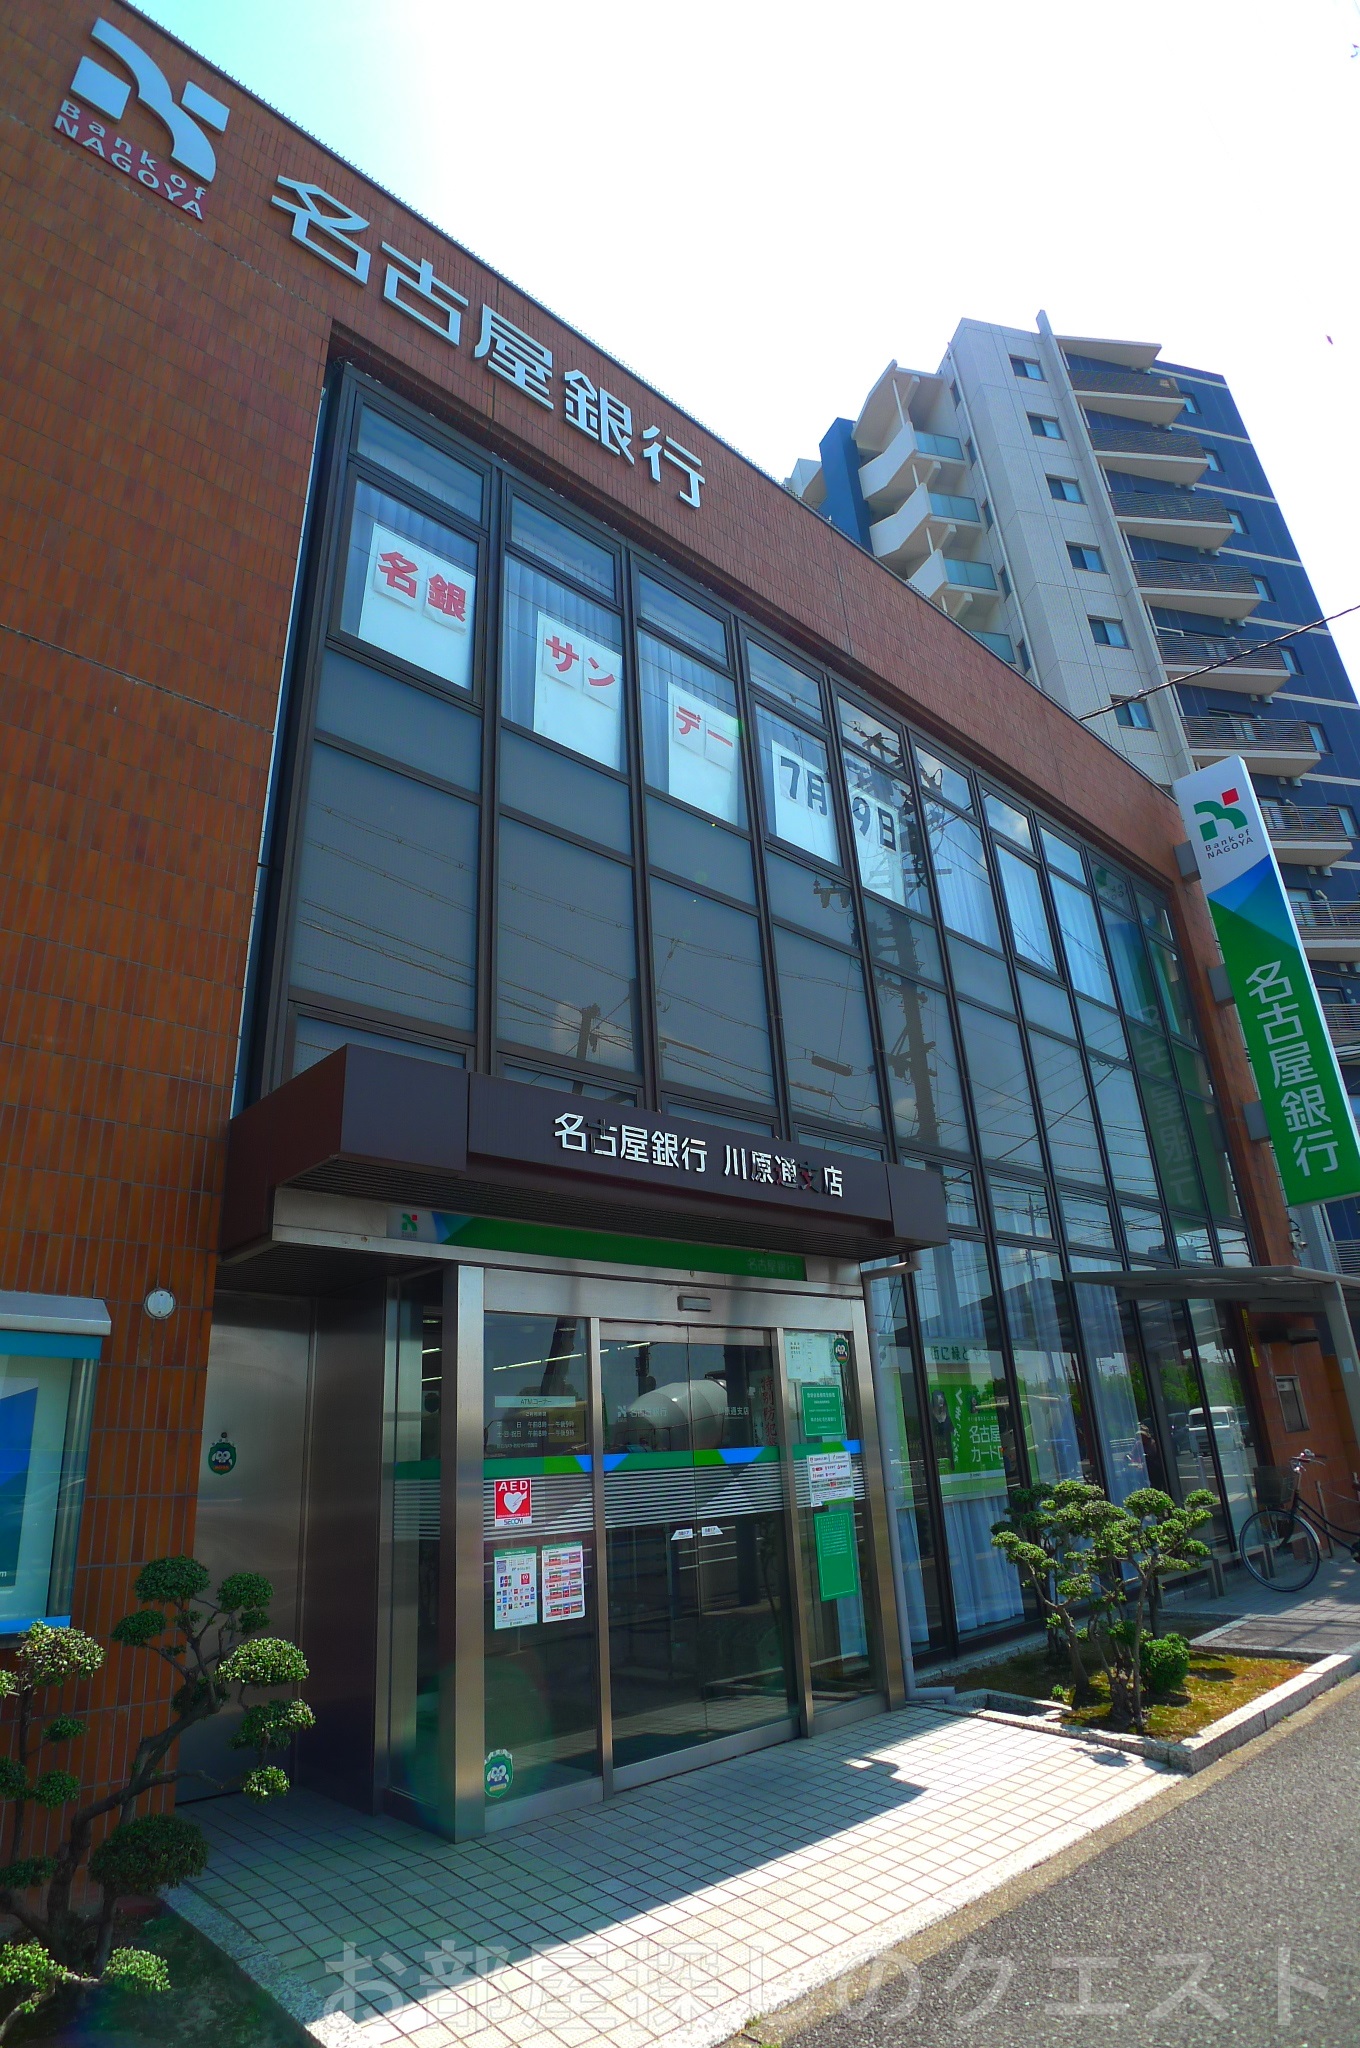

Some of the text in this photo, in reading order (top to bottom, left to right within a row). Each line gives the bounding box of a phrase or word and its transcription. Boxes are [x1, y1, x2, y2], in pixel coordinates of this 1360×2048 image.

[54, 115, 203, 220] NAGOYA
[61, 100, 207, 201] Bank of
[271, 174, 706, 509] 名古屋銀行
[377, 551, 897, 852] 名銀 サン デー 7月 9日
[1205, 829, 1249, 852] Bank of
[1207, 837, 1254, 859] NAGOYA
[1245, 960, 1339, 1177] 名古屋銀行
[554, 1112, 844, 1198] 名古屋銀行 川原通支店
[520, 1398, 553, 1406] ATMコーナー
[498, 1480, 528, 1492] AED
